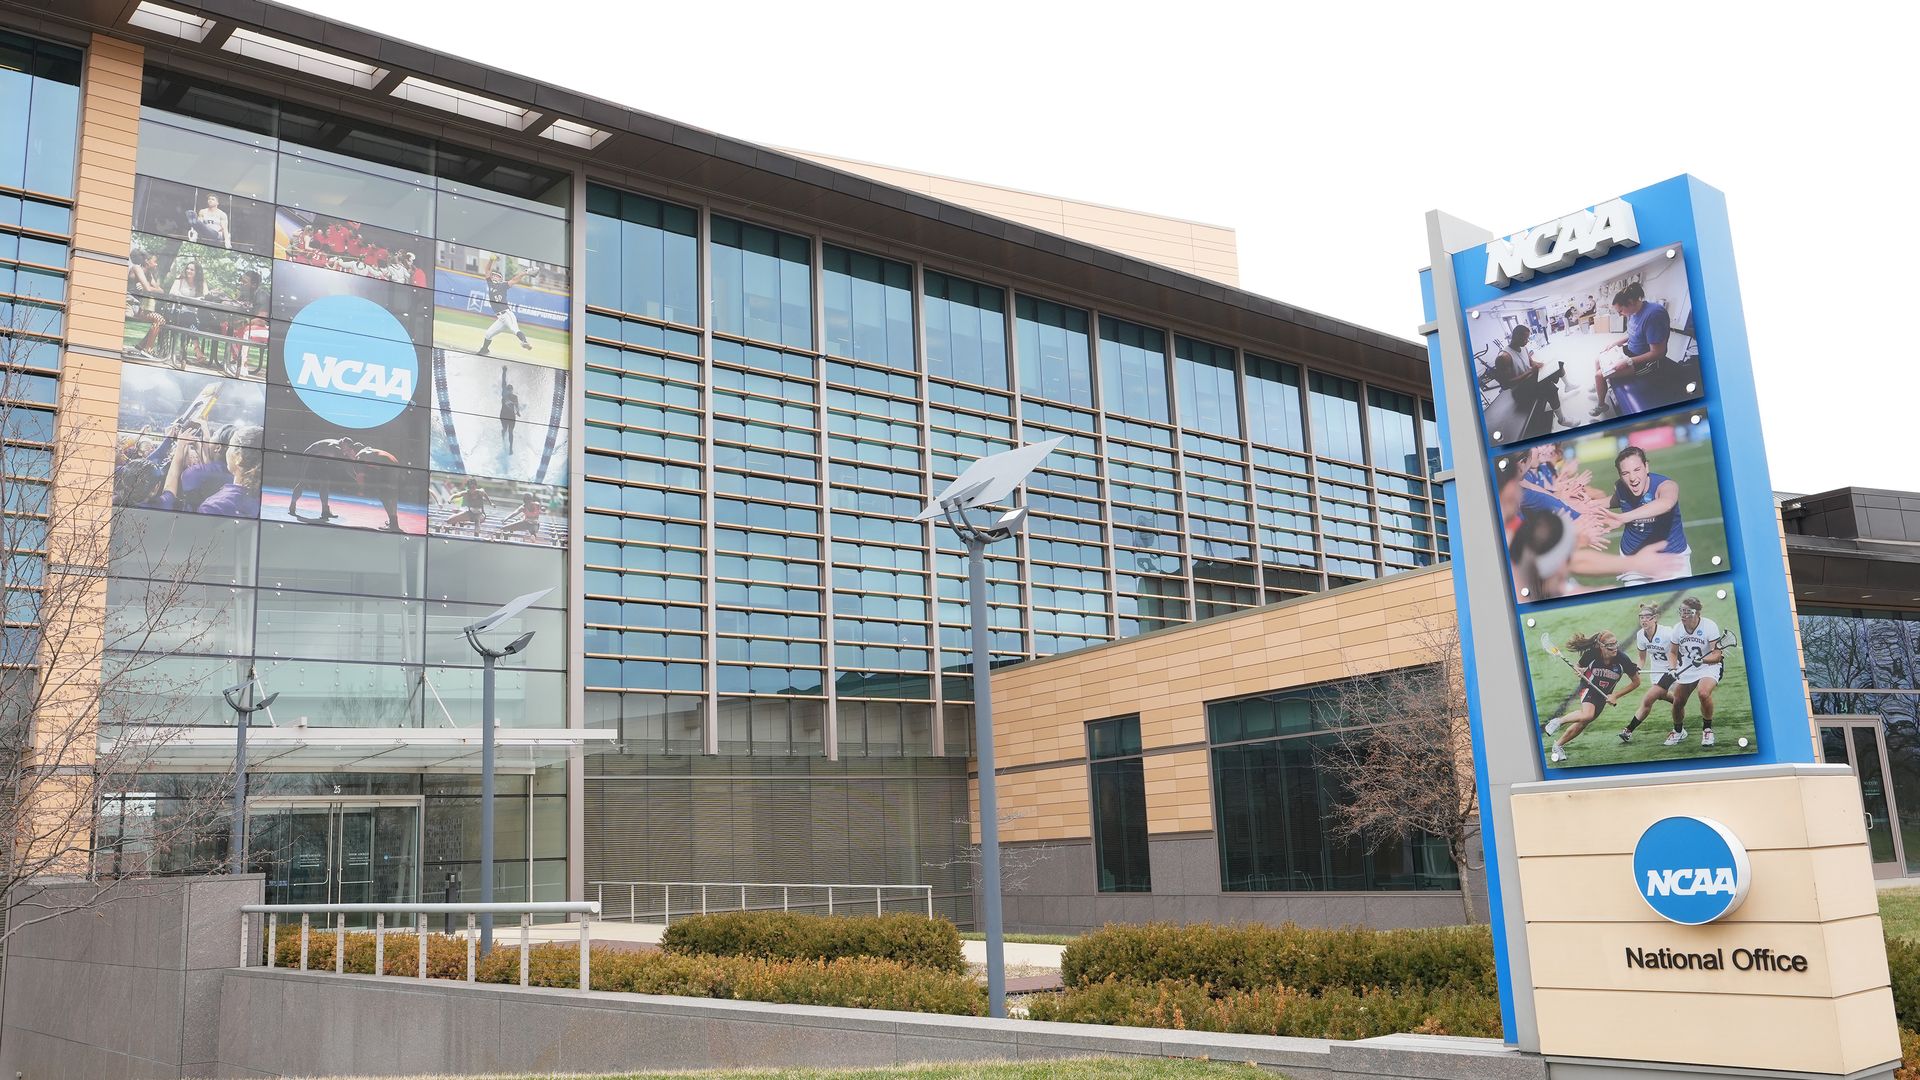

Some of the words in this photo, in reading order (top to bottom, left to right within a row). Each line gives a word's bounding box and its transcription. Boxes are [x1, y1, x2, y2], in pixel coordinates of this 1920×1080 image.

[1485, 197, 1640, 289] NCAA
[297, 352, 412, 401] NCAA
[1647, 867, 1737, 897] NCAA
[1625, 947, 1724, 971] National
[1732, 947, 1808, 972] Office
